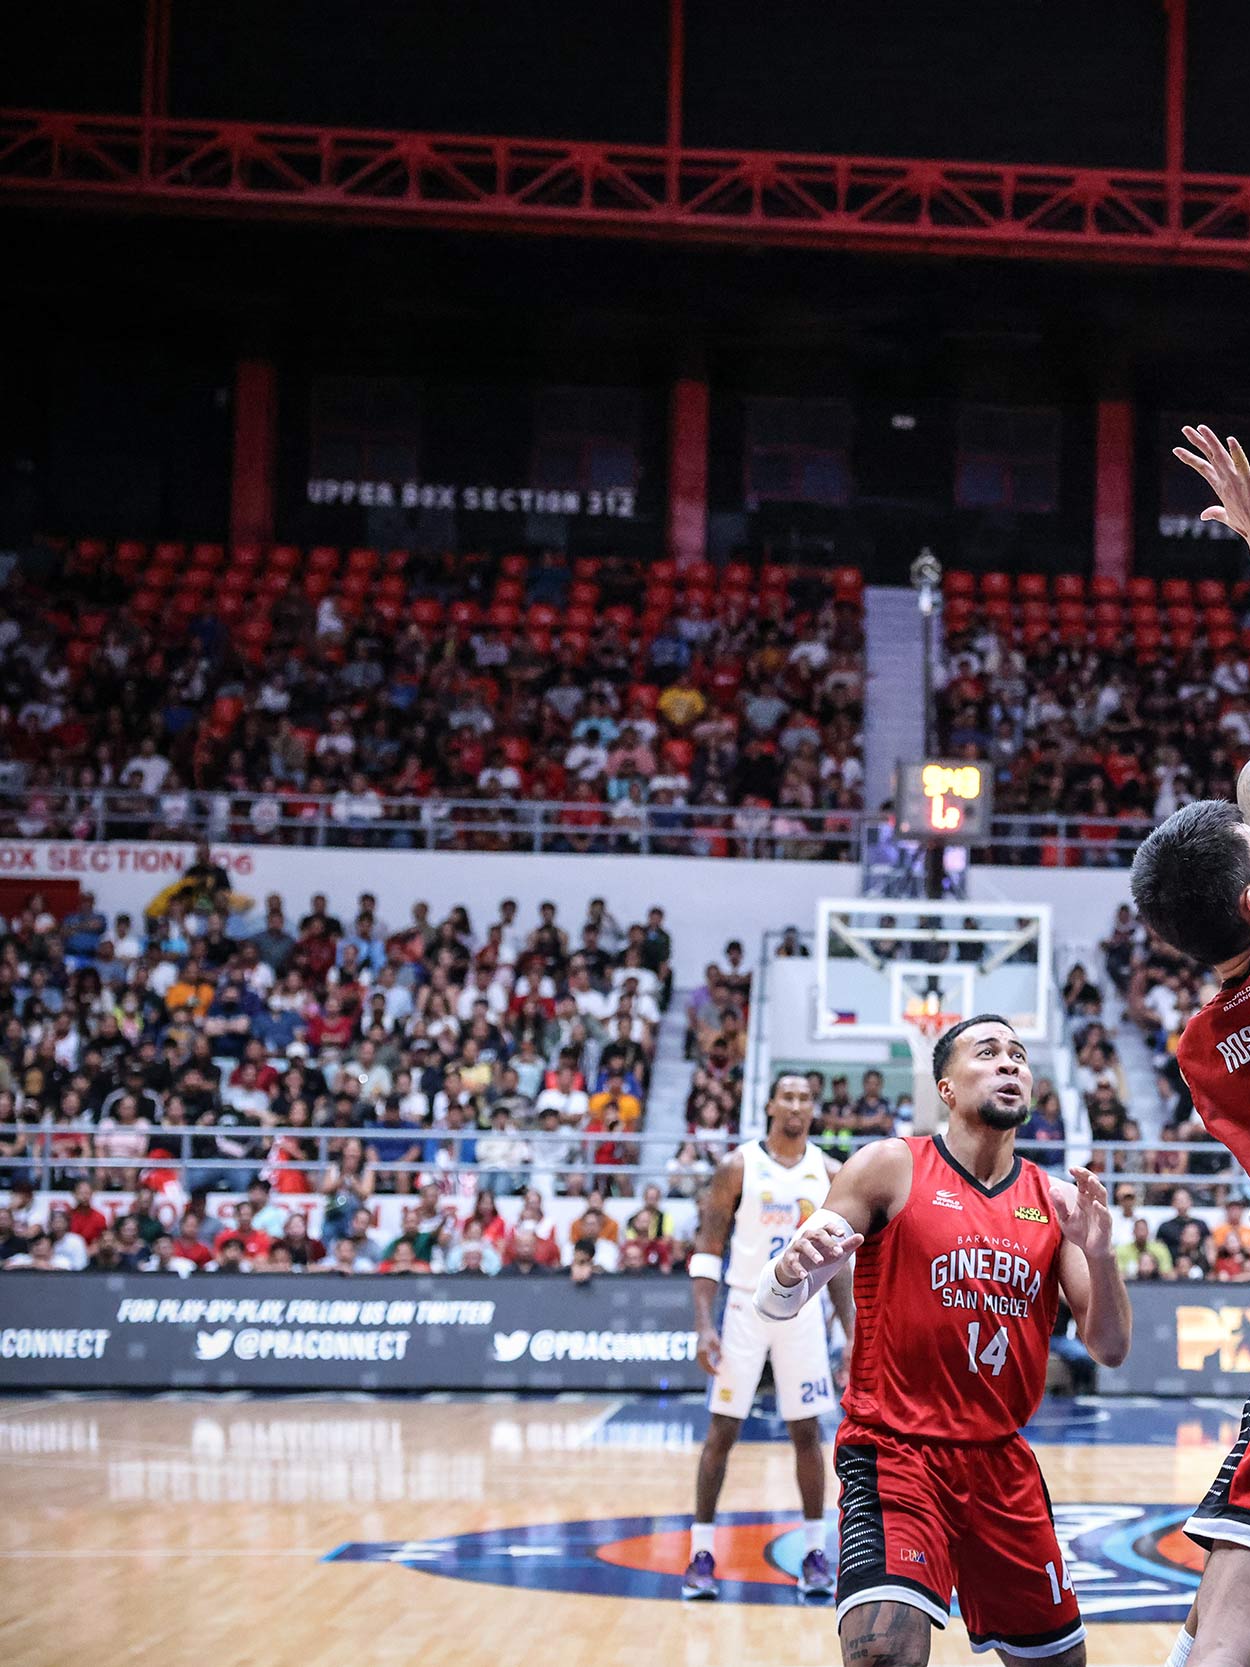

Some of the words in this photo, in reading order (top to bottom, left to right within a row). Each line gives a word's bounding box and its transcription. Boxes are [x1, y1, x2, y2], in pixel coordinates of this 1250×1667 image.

[307, 479, 393, 506] UPPER
[401, 482, 456, 509] BOX
[463, 486, 581, 515] SECTION
[0, 849, 36, 871] OX
[48, 849, 184, 873] SECTION
[211, 851, 254, 876] 06
[957, 1235, 1029, 1254] BARANGAY
[931, 1248, 1042, 1303] GINEBRA
[117, 1299, 157, 1323] FOR
[285, 1300, 361, 1324] FOLLOW
[359, 1301, 387, 1325] US
[386, 1301, 416, 1325] ON
[415, 1301, 496, 1325] TWITTER
[942, 1288, 978, 1311] SAN
[983, 1292, 1029, 1318] MIGUEL
[0, 1329, 110, 1358] CONNECT
[233, 1329, 411, 1361] @PBACONNECT
[529, 1329, 699, 1362] @PBACONNECT
[967, 1321, 1010, 1377] 14
[800, 1377, 829, 1403] 24
